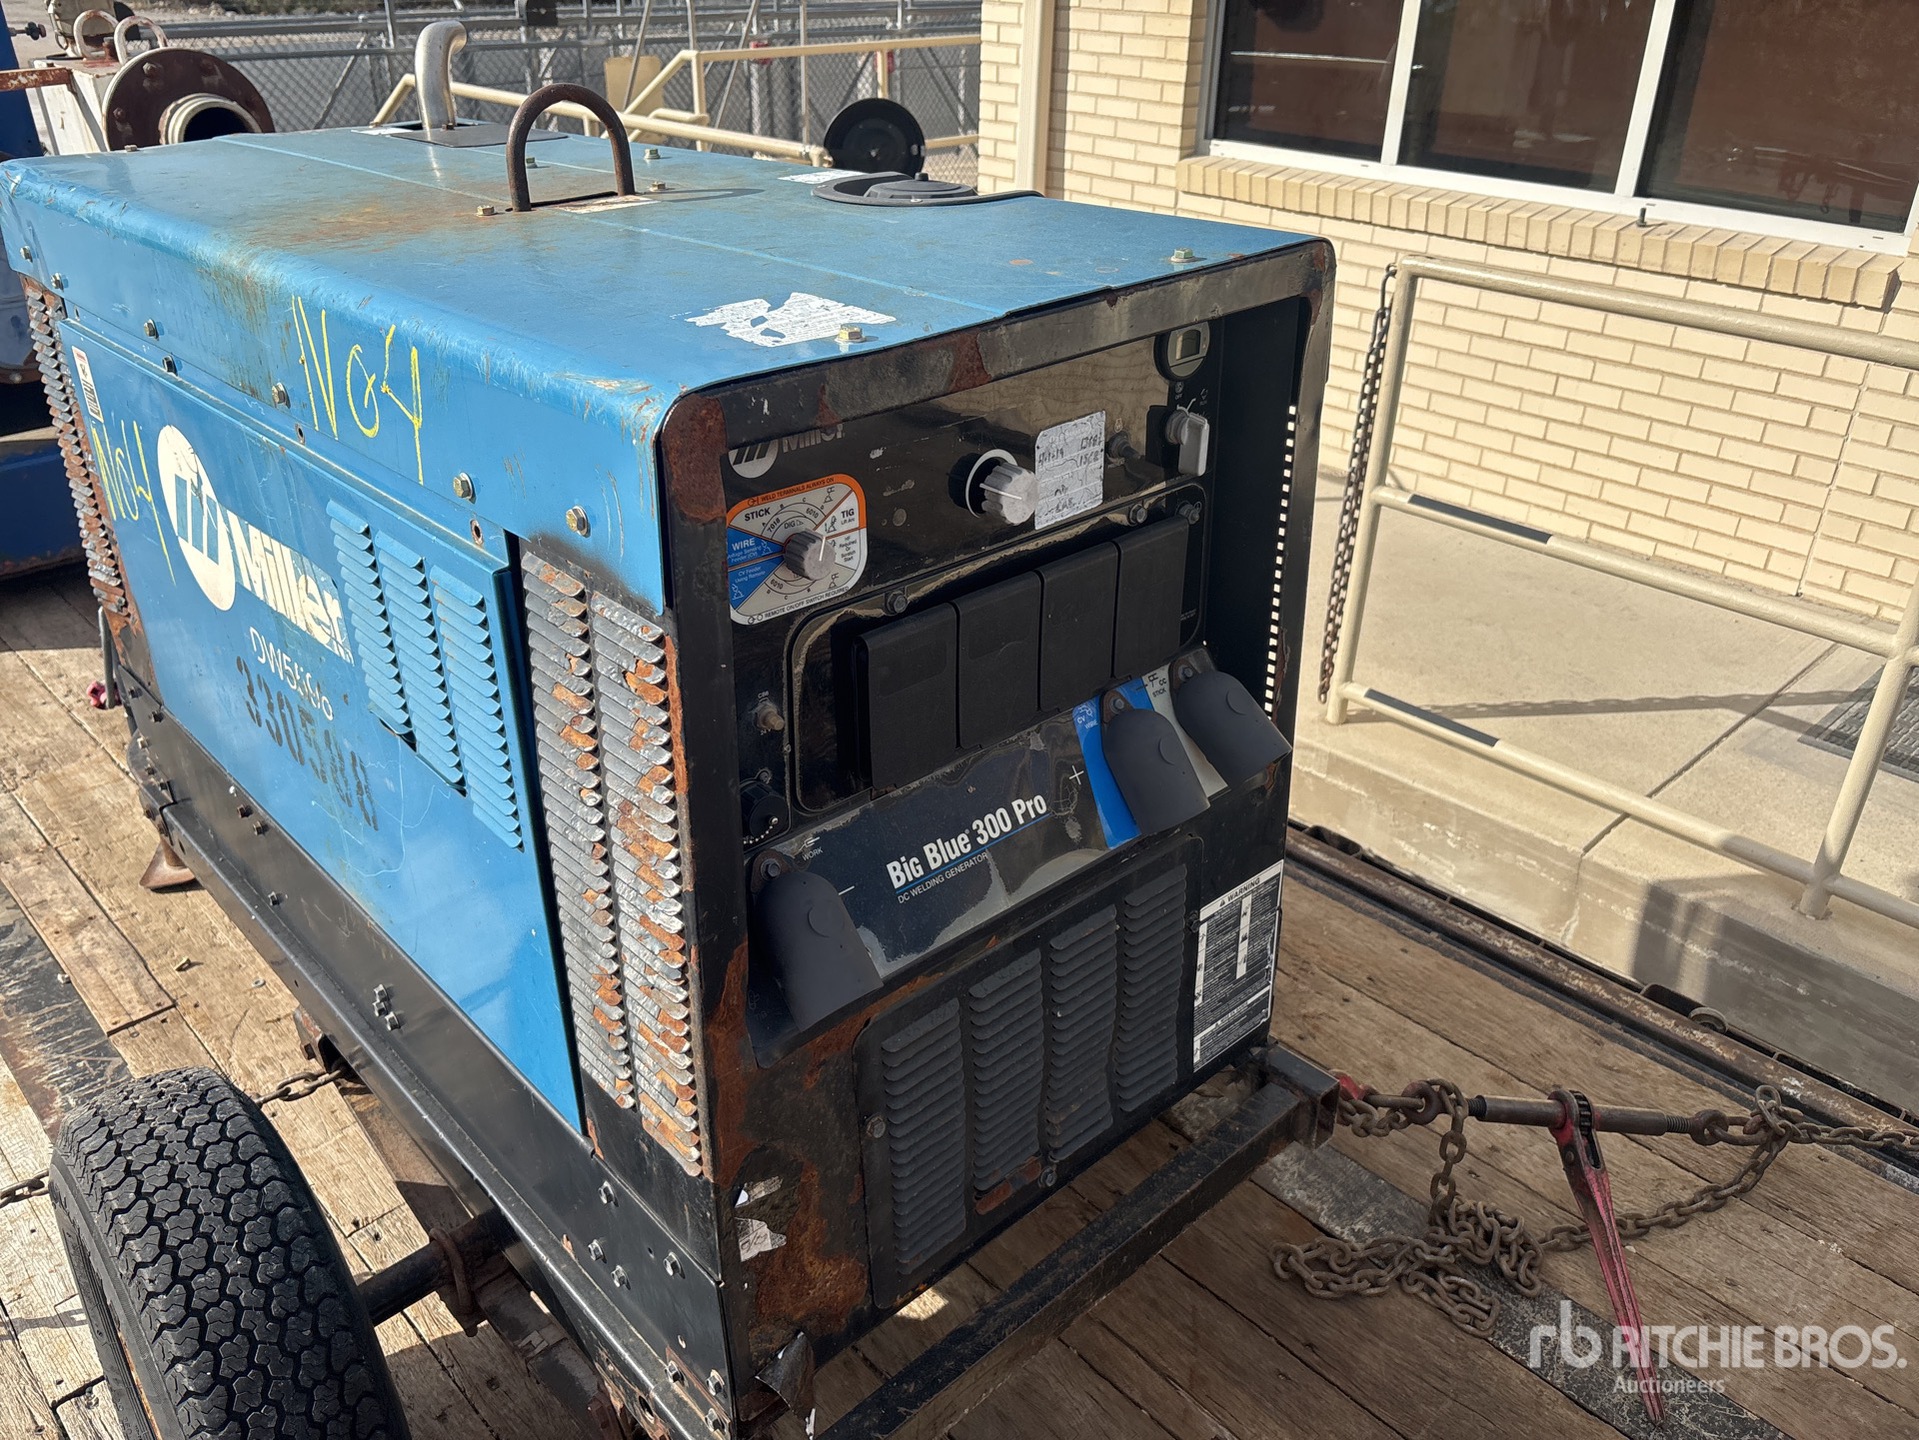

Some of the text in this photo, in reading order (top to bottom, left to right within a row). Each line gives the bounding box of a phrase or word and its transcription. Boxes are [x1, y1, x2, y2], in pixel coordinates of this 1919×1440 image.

[761, 477, 835, 502] WELD TERMINALS ALWAYS ON
[744, 507, 771, 522] STICK
[805, 507, 820, 519] 6010
[840, 508, 855, 519] TIG
[766, 517, 782, 533] 7018
[783, 518, 797, 530] DIG
[731, 537, 756, 551] WIRE
[734, 576, 748, 584] Using
[738, 569, 746, 577] CV
[226, 509, 354, 666] Miller
[770, 579, 784, 590] 6010
[764, 586, 850, 619] REMOTE ON/OFF SWITCH REQUIRED
[1158, 677, 1167, 686] CC
[1152, 687, 1167, 698] STICK
[1076, 715, 1086, 724] CV
[886, 855, 925, 889] Big
[971, 807, 1013, 845] 300
[1011, 794, 1048, 825] Pro
[802, 846, 824, 862] WORK
[897, 851, 989, 904] DC WELDING GENERATOR
[1226, 877, 1261, 903] WARNING
